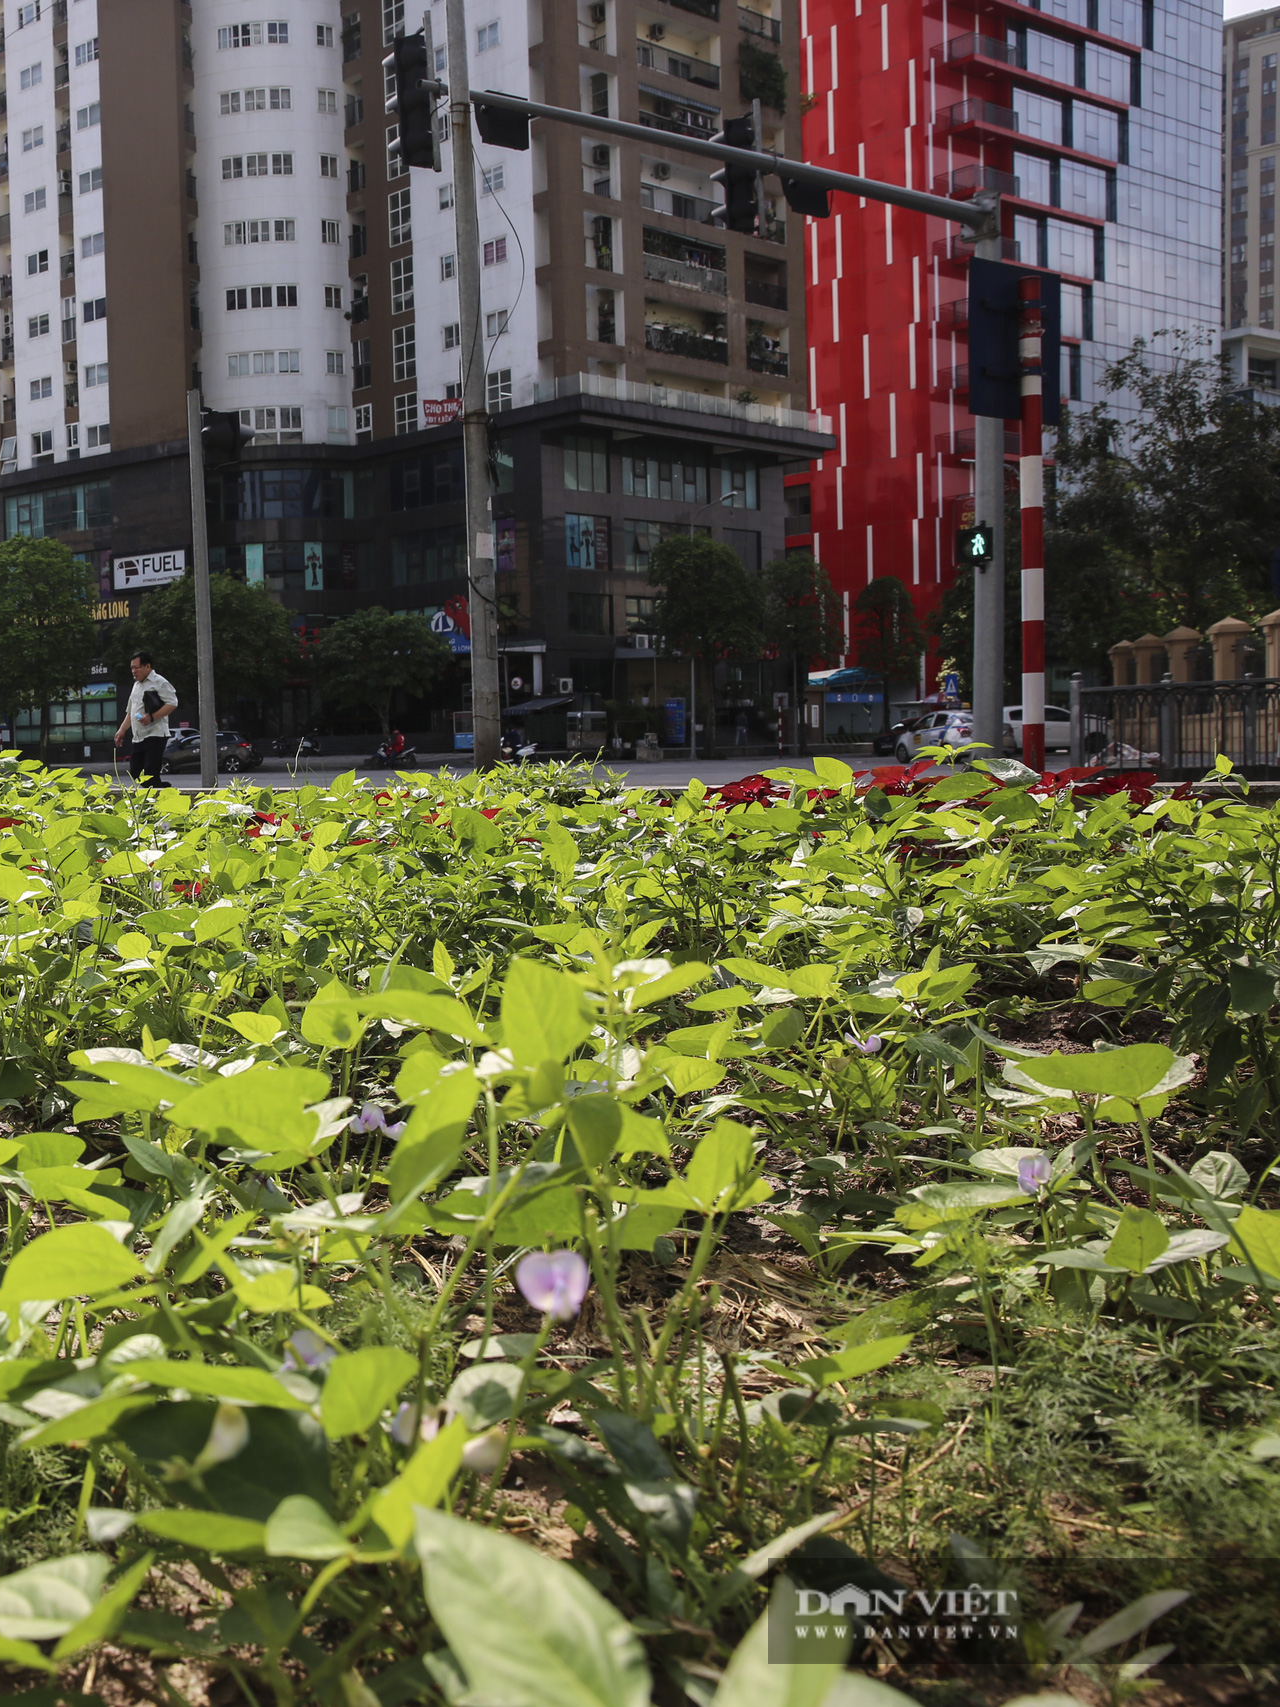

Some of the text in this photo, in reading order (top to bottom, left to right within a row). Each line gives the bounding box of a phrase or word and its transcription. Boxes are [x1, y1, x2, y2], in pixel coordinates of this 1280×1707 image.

[425, 403, 442, 414] CHO
[142, 554, 182, 575] FUEL
[108, 600, 130, 619] LONG
